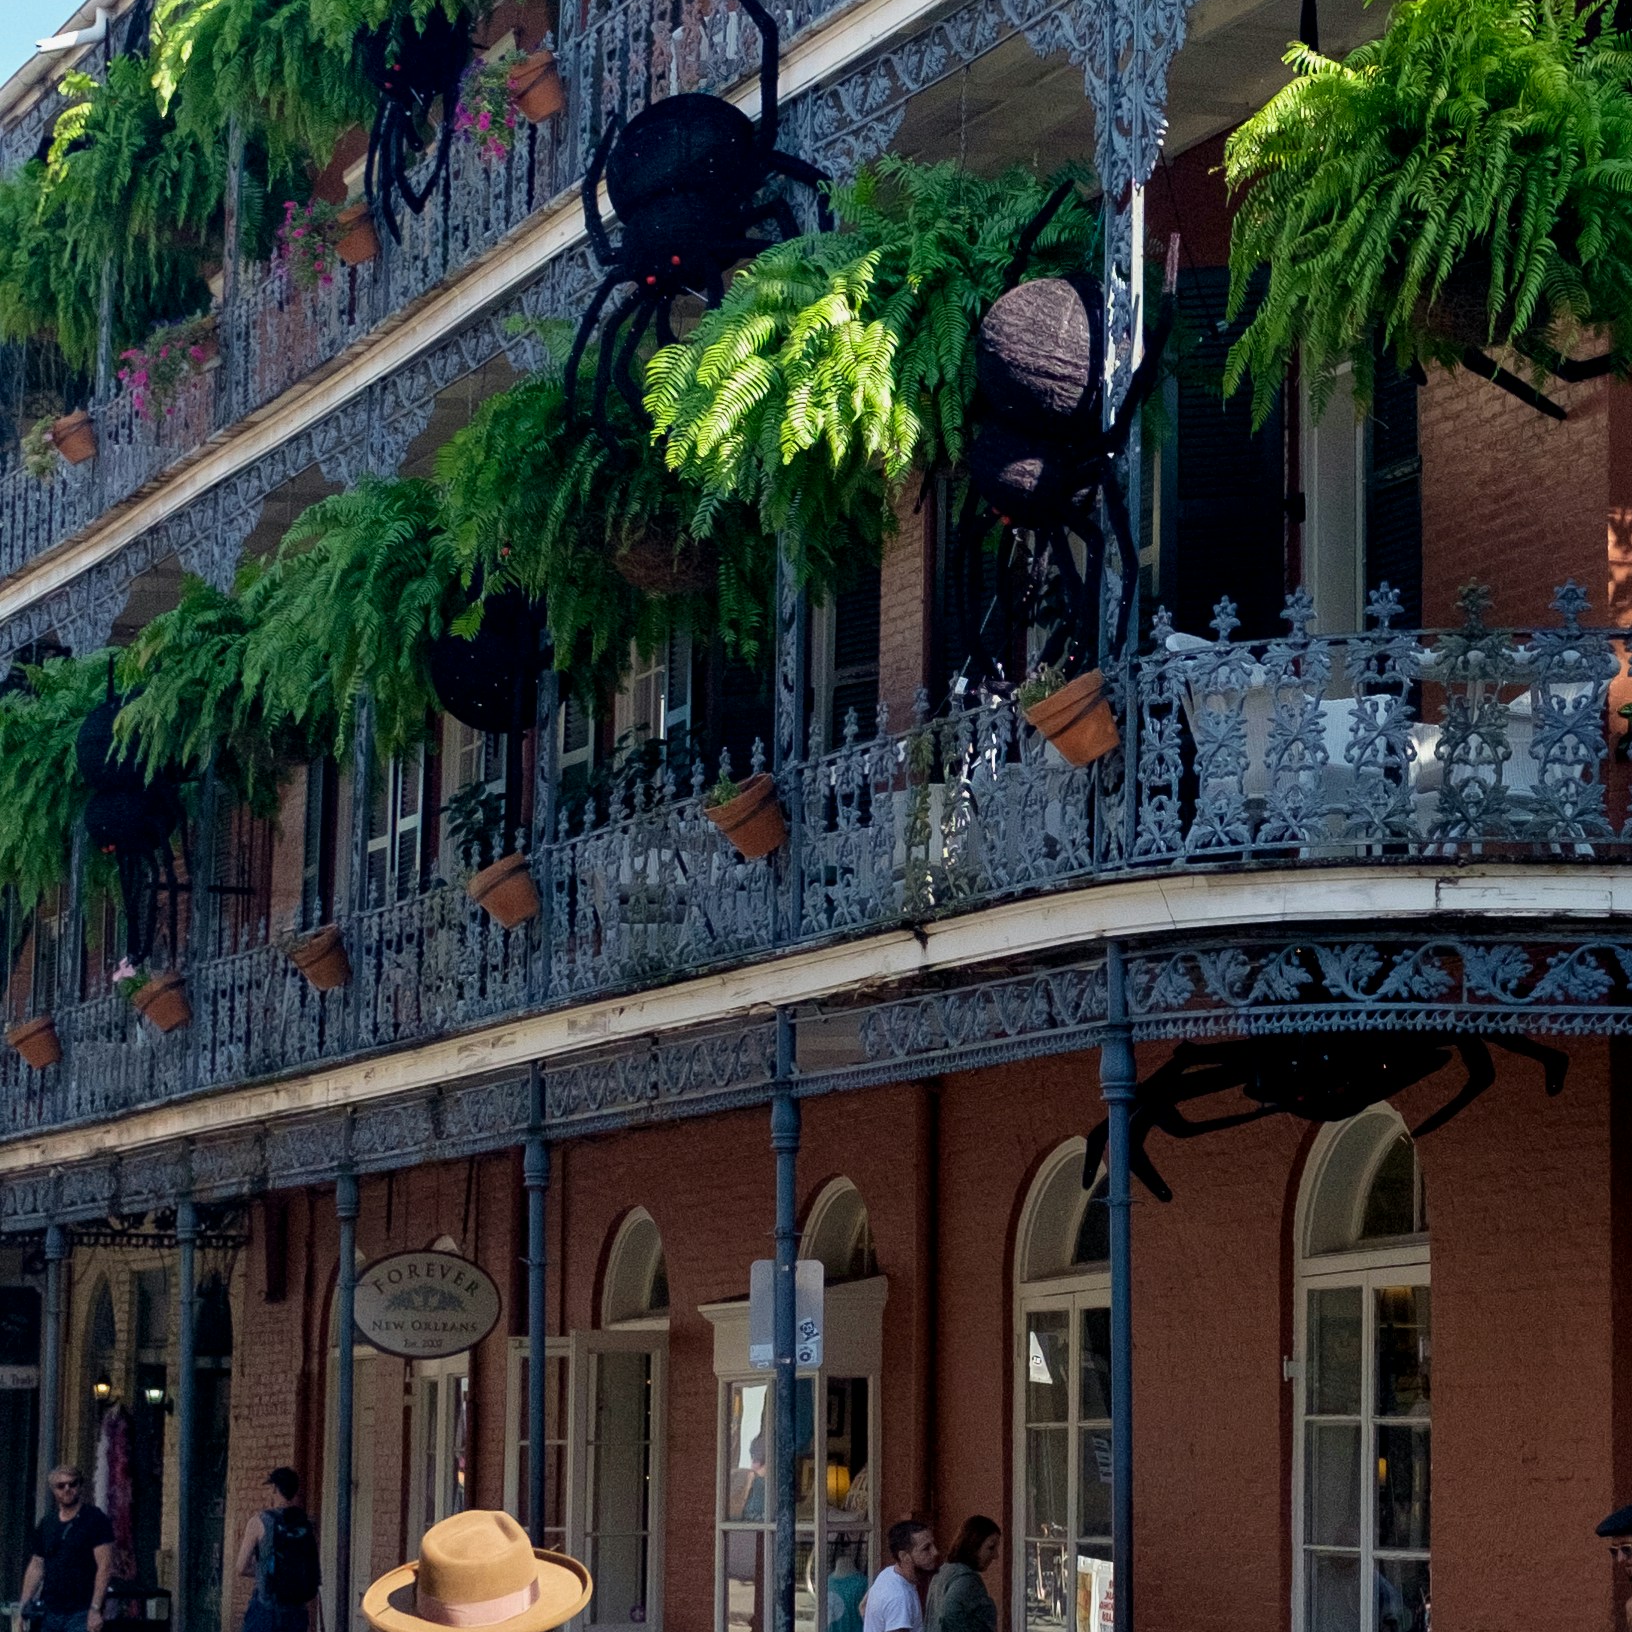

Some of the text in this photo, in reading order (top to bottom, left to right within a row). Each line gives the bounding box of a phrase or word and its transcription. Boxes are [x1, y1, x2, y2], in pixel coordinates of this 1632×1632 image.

[372, 1264, 478, 1297] FOREVER
[371, 1321, 477, 1332] NEW ORLEANS
